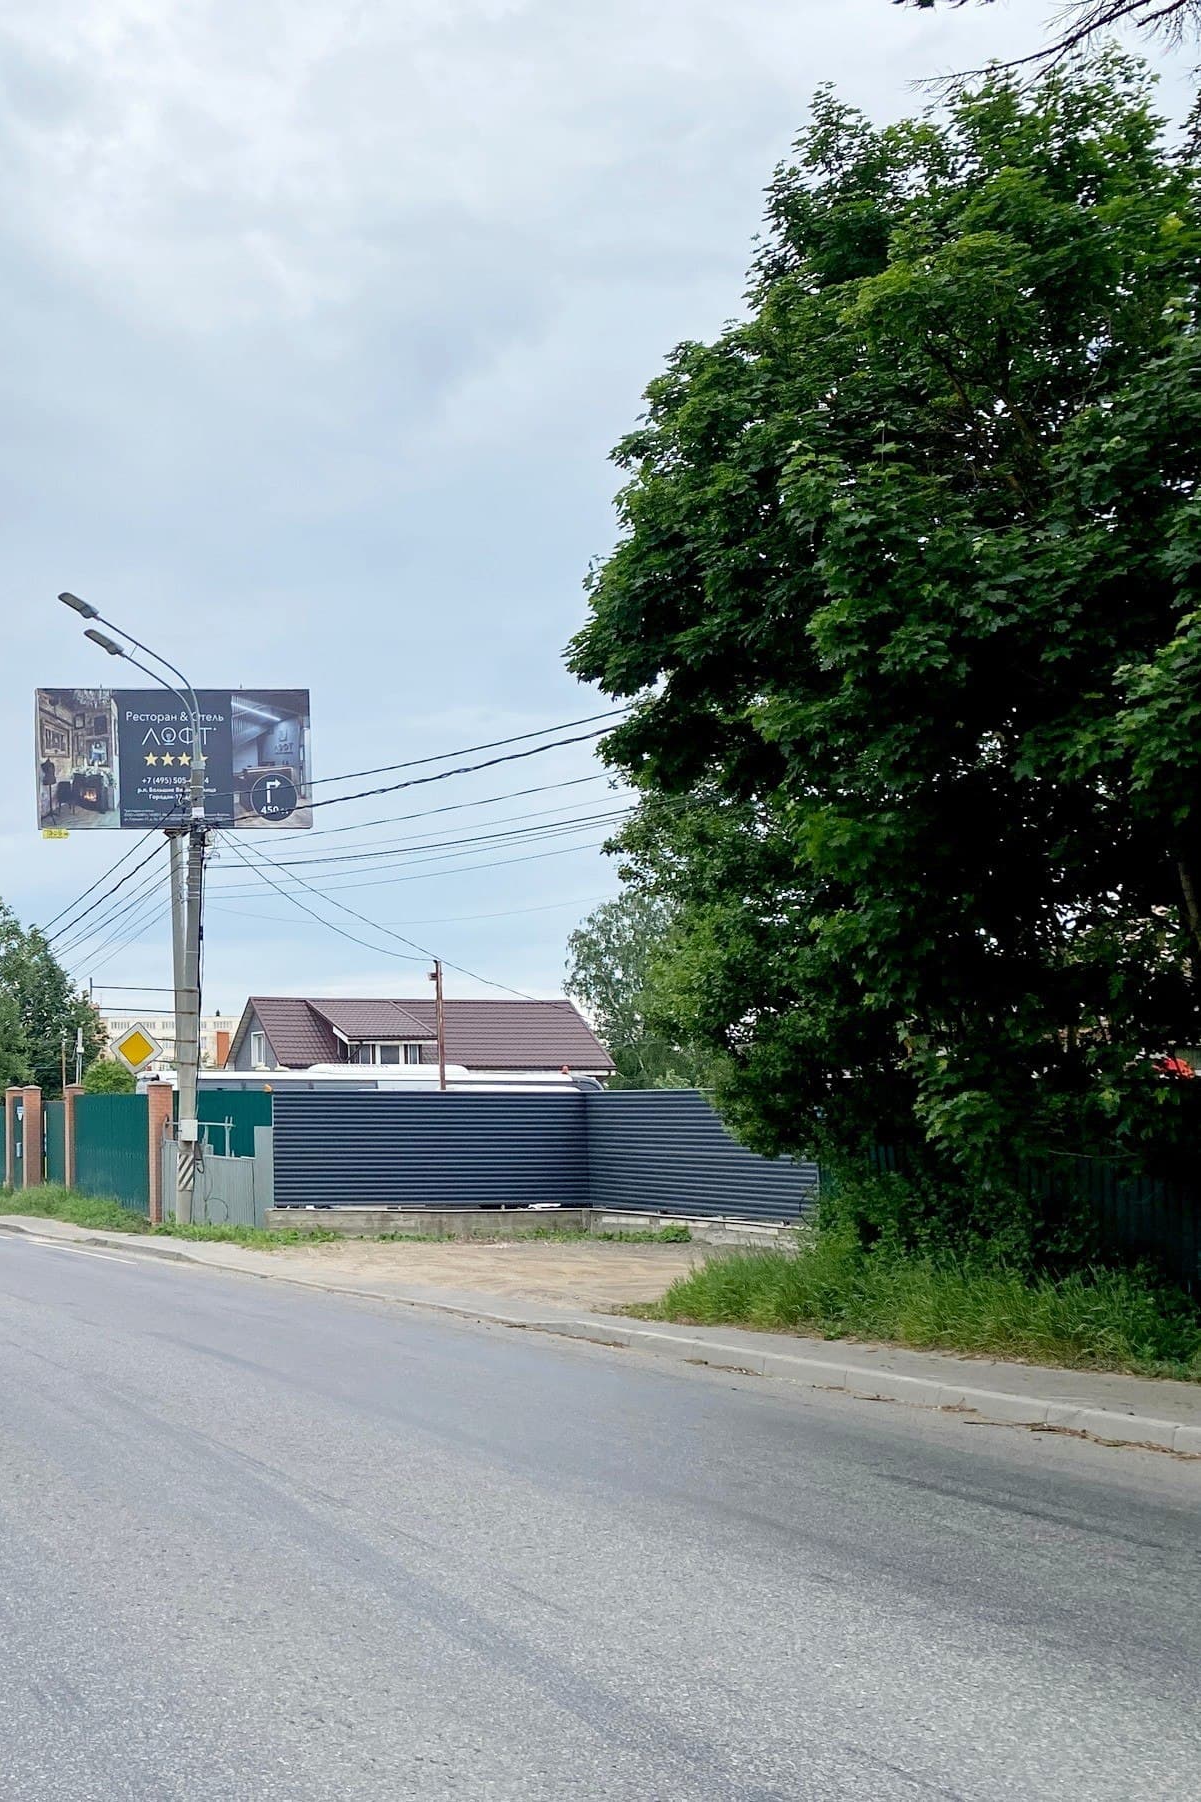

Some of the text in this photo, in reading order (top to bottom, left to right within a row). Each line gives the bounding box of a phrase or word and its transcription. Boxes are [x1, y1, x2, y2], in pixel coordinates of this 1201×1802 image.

[125, 711, 178, 723] Ресторан
[179, 711, 189, 722] &
[141, 727, 213, 746] ЛОФТ
[142, 776, 152, 784] +7
[152, 776, 172, 785] (495)
